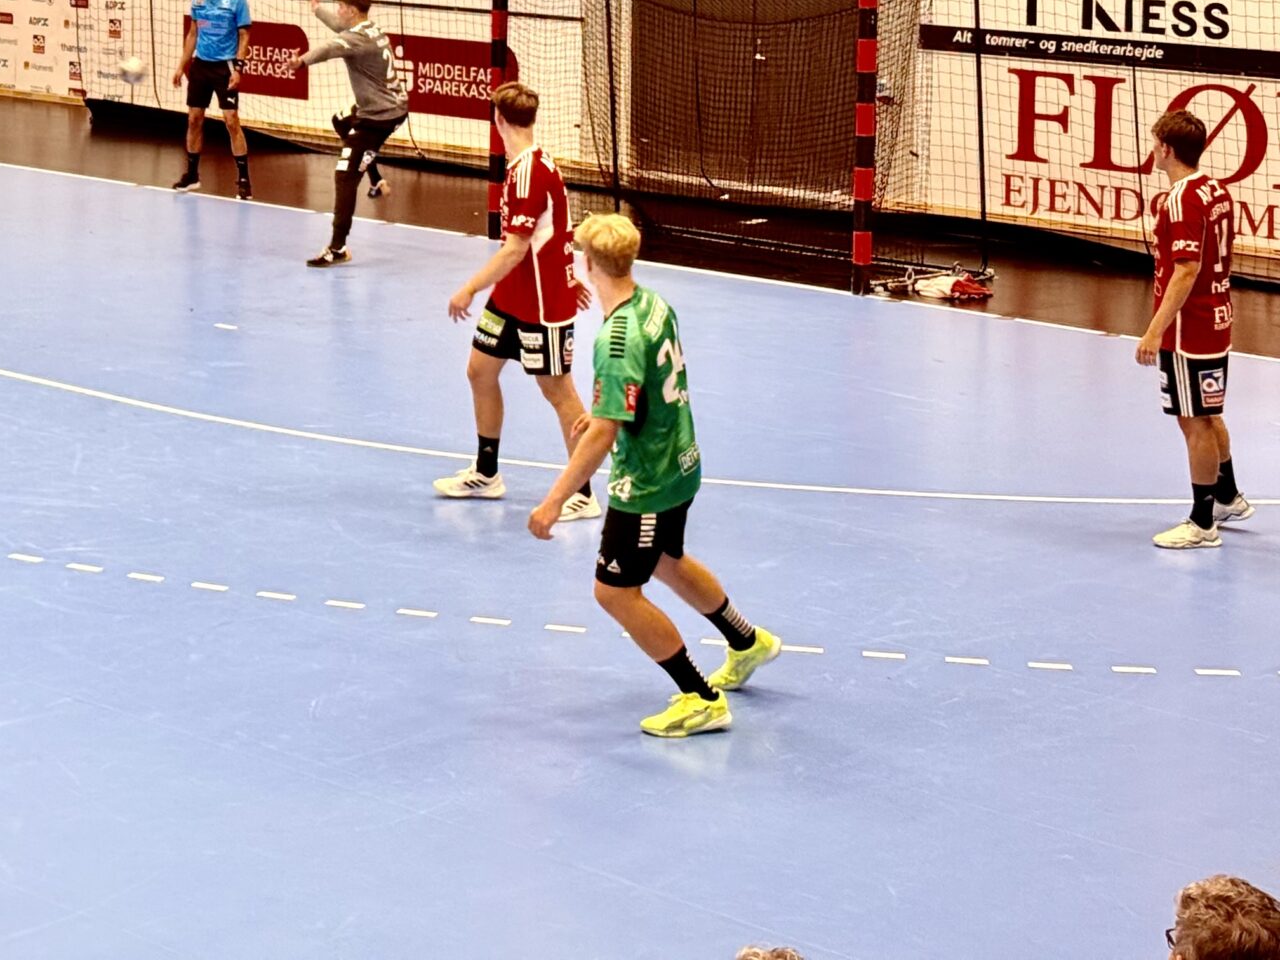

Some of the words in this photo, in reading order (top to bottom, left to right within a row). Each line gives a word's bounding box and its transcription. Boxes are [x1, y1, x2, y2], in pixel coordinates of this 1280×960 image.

[952, 30, 972, 44] Alt
[1039, 39, 1056, 54] og
[1061, 40, 1164, 61] snedkerarbejde
[418, 61, 492, 84] MIDDELFA
[417, 77, 492, 101] SPAREKASS
[1005, 67, 1280, 186] FLØ
